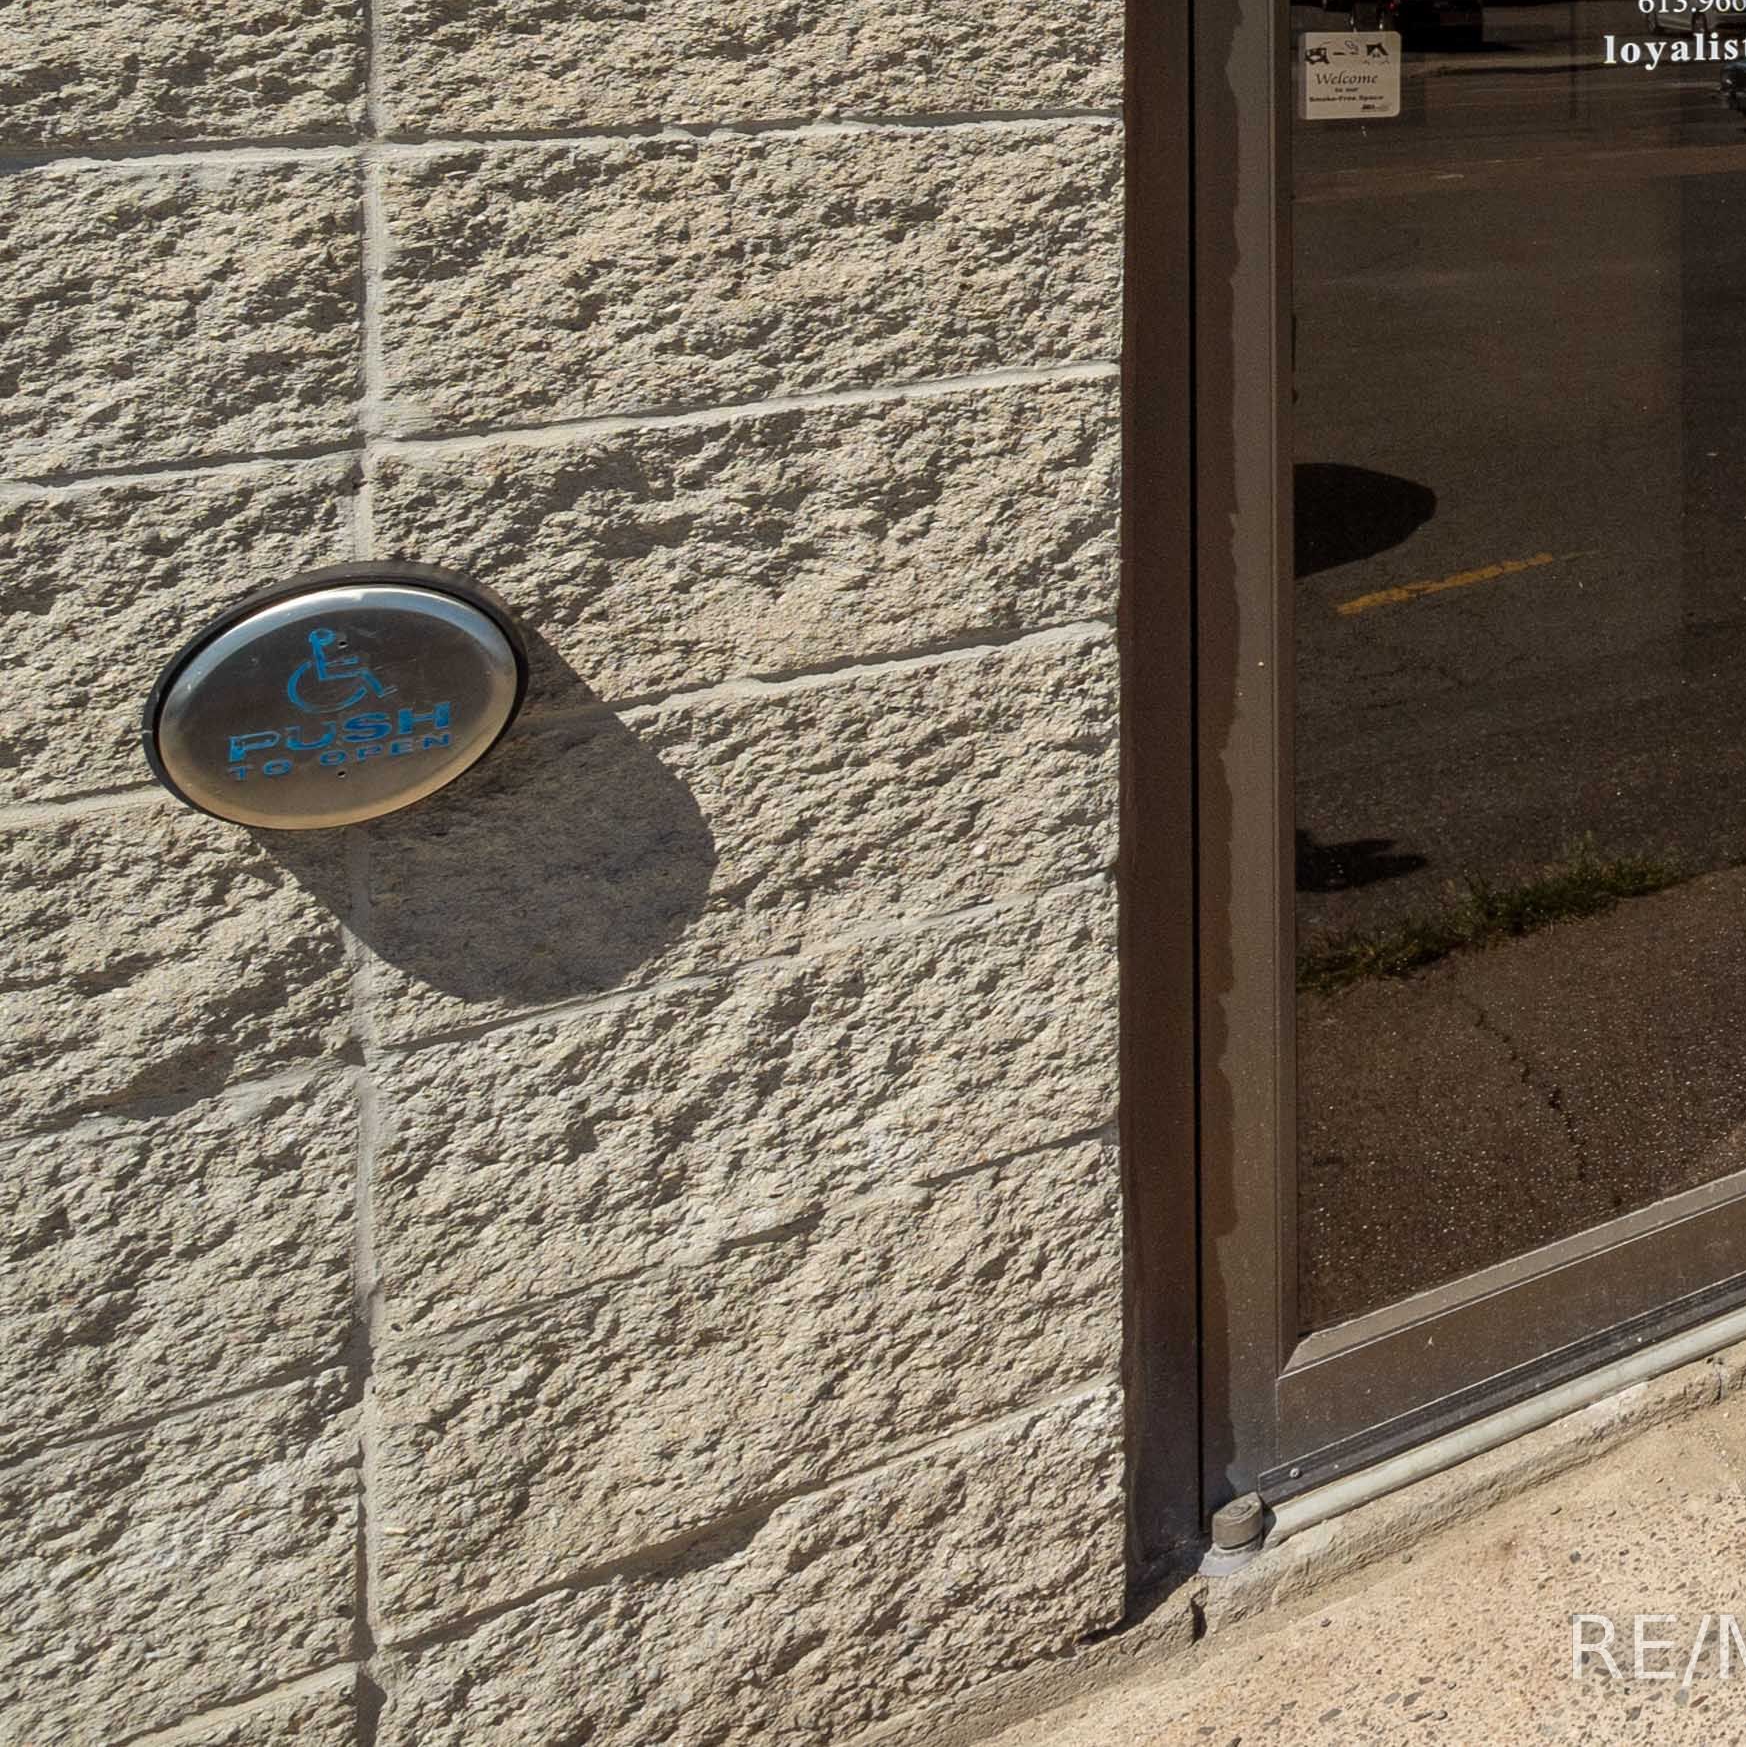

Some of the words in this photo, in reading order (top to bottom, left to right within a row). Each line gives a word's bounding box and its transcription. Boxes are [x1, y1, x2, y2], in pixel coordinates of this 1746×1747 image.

[1315, 71, 1379, 85] Welcome
[228, 702, 451, 763] PUSH
[228, 759, 290, 780] TO
[320, 733, 450, 765] OPEN
